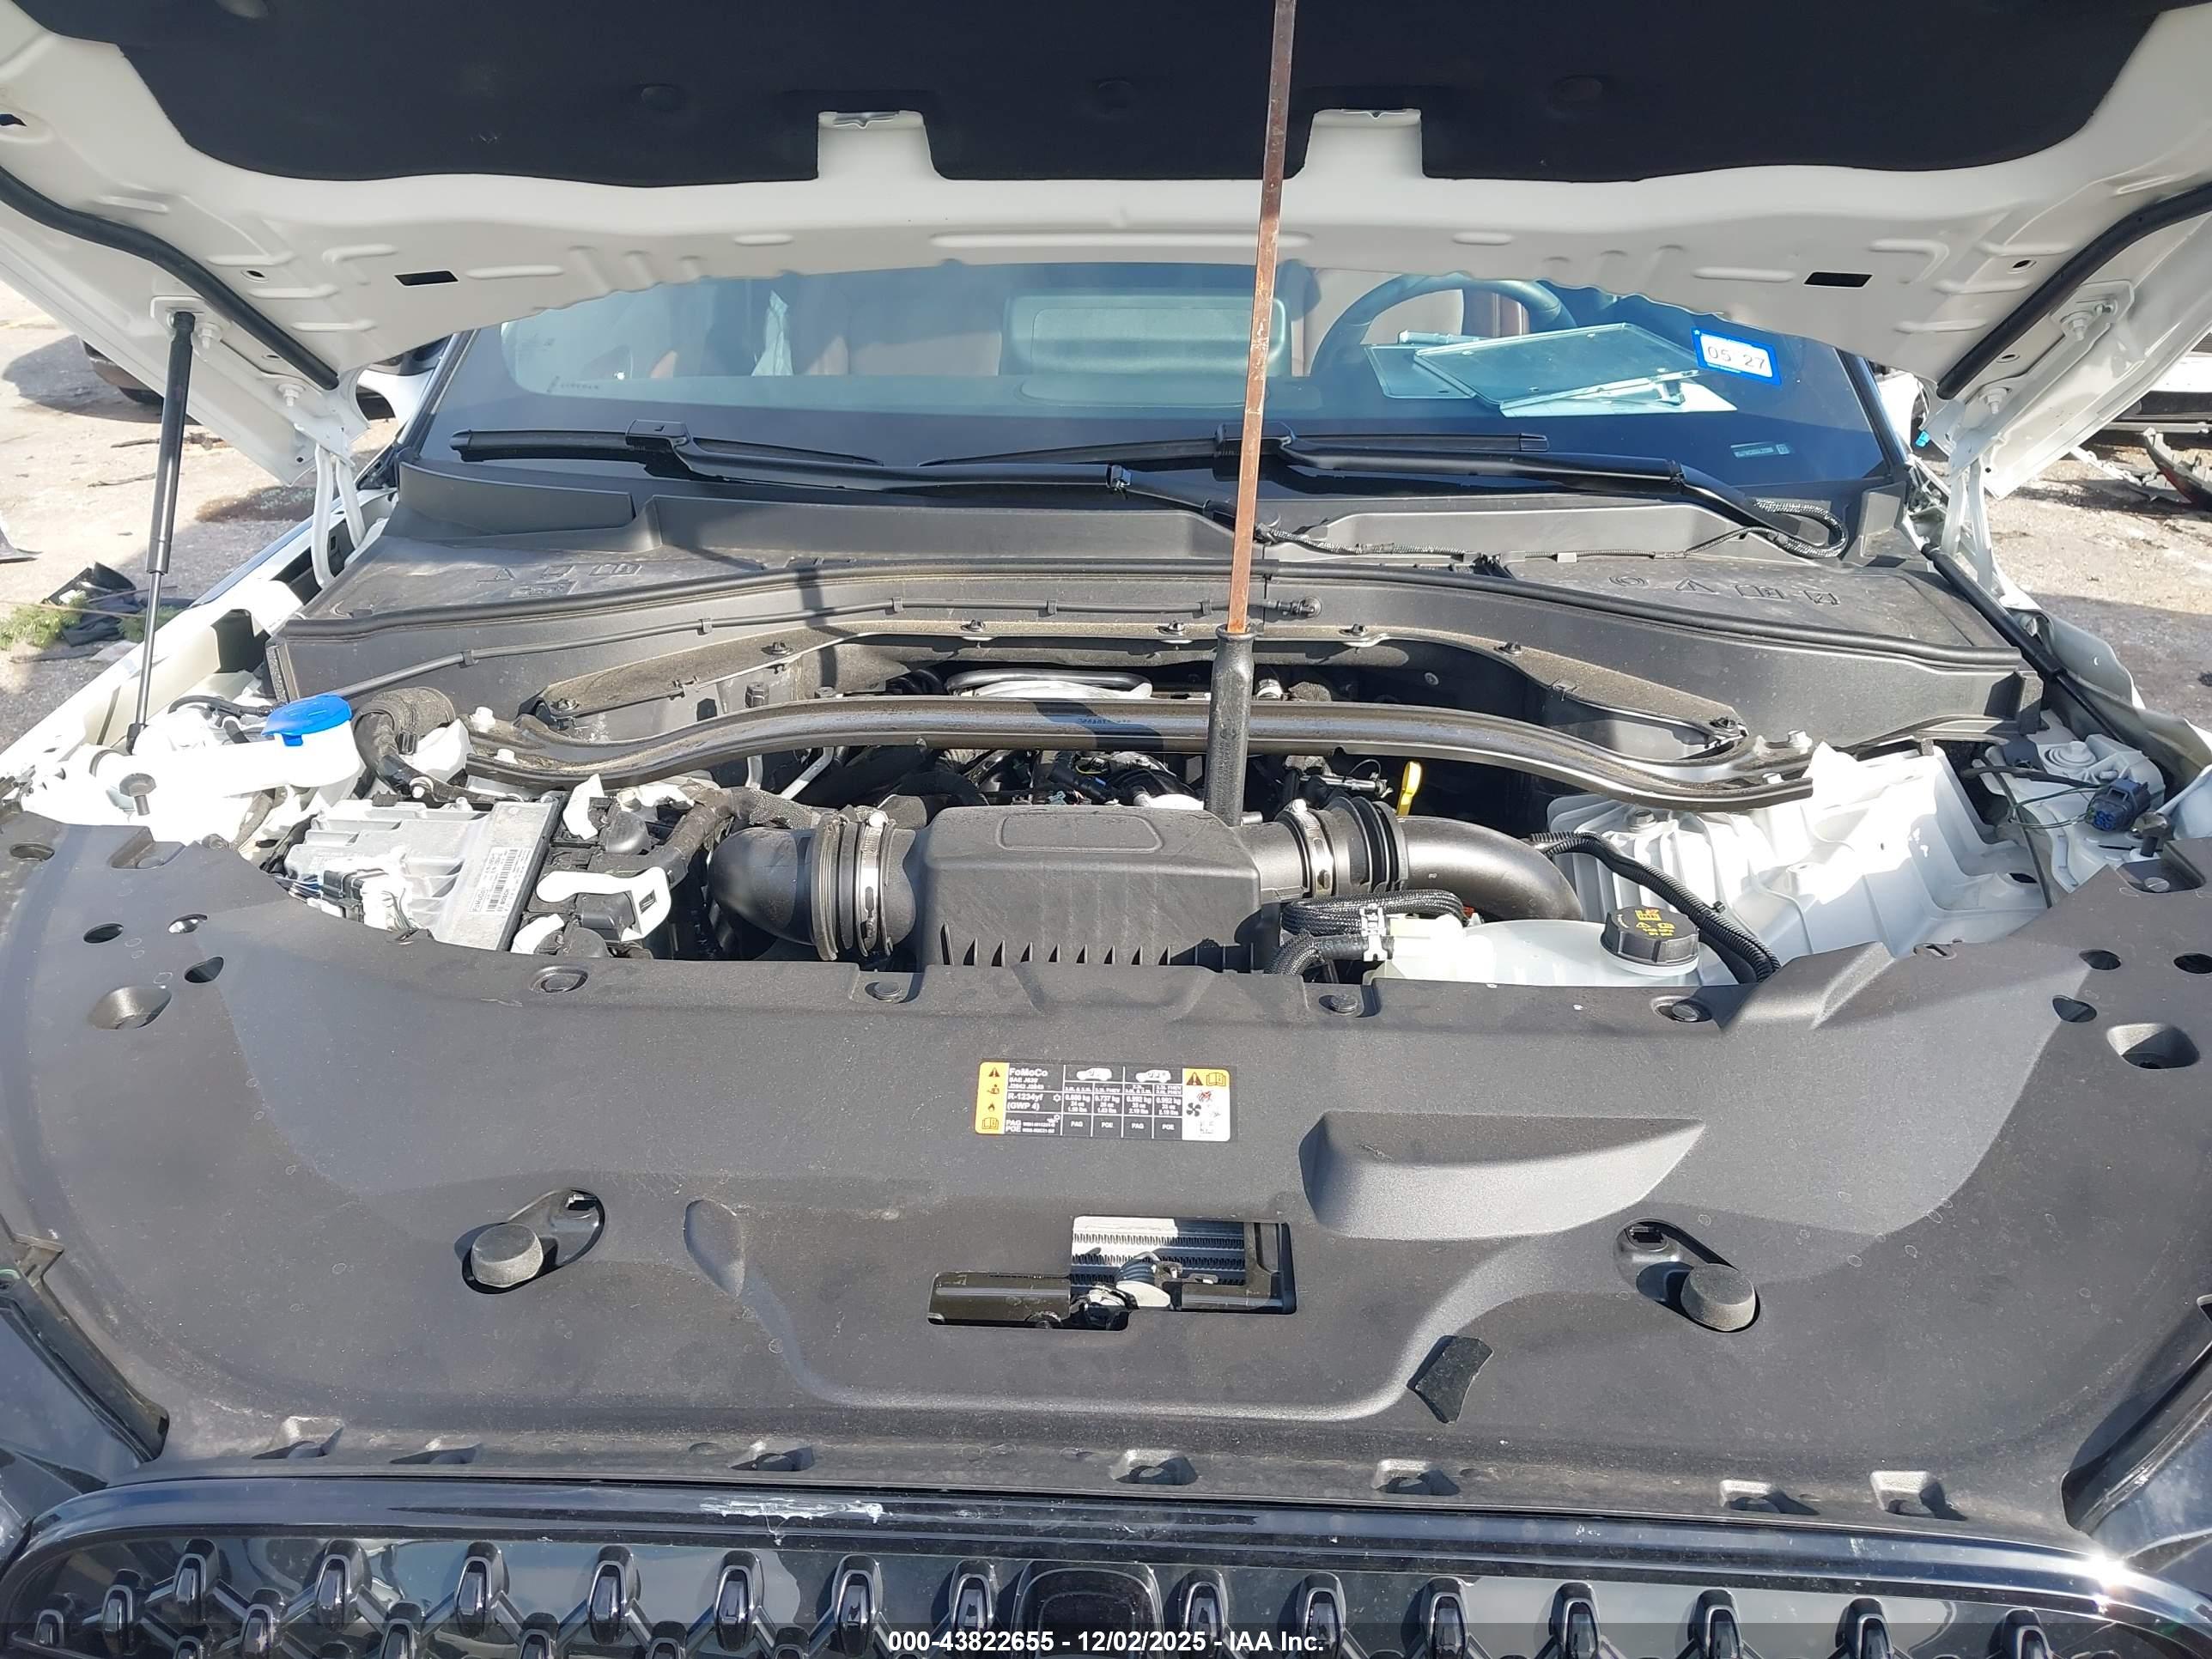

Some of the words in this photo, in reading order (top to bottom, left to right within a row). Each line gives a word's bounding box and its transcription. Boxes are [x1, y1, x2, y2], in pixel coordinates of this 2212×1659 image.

[1707, 345, 1732, 362] 05
[1743, 353, 1765, 370] 27
[1009, 1067, 1048, 1077] FoMoCo
[1008, 1092, 1044, 1102] R-1234yf
